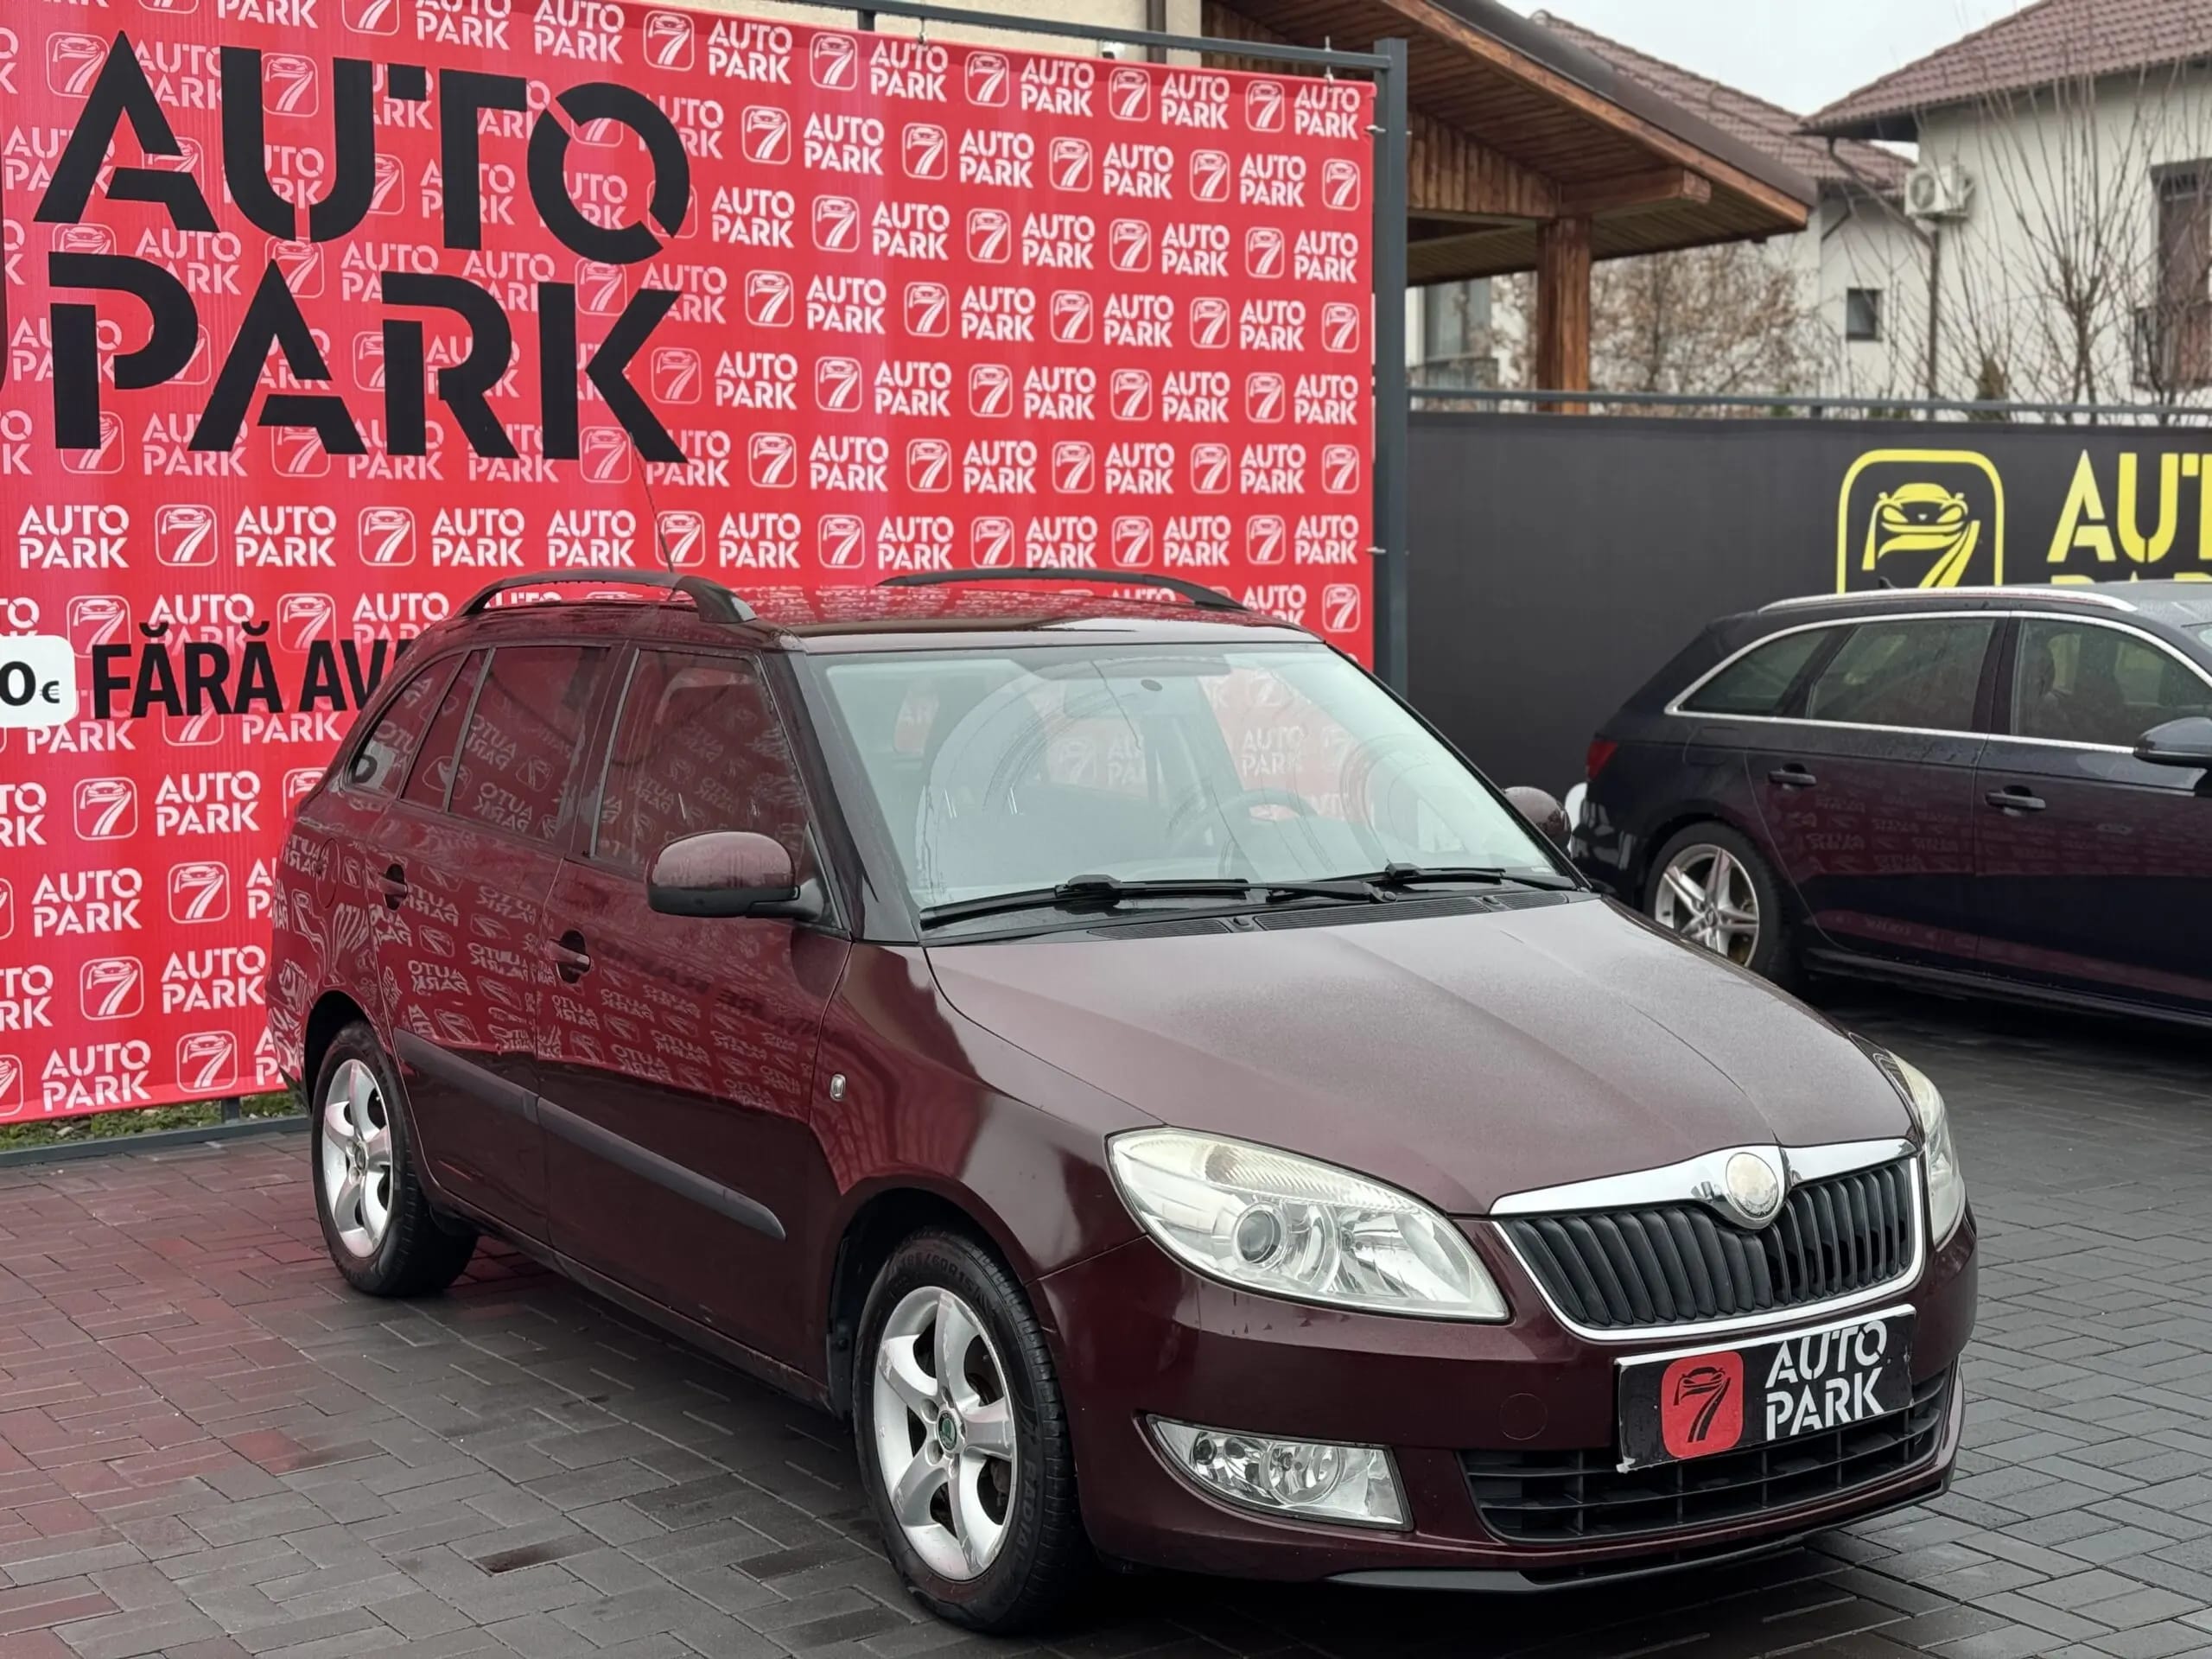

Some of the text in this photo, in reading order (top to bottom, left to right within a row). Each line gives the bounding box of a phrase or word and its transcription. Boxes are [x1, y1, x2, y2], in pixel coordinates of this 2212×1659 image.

[416, 11, 510, 50] PARK
[533, 0, 624, 33] AUTO
[535, 25, 622, 63] PARK
[708, 20, 792, 54] AUTO
[709, 47, 791, 84] PARK
[869, 40, 948, 73] AUTO
[871, 67, 946, 102] PARK
[1020, 59, 1094, 89] AUTO
[1161, 74, 1229, 103] AUTO
[1021, 83, 1092, 117] PARK
[1161, 98, 1229, 129] PARK
[1294, 86, 1360, 115] AUTO
[804, 112, 884, 146] AUTO
[1294, 110, 1360, 140] PARK
[33, 29, 690, 264] AUTO
[804, 141, 884, 175] PARK
[959, 130, 1034, 161] AUTO
[1103, 143, 1173, 172] AUTO
[960, 156, 1033, 188] PARK
[1240, 154, 1306, 181] AUTO
[1103, 168, 1173, 199] PARK
[1240, 179, 1306, 207] PARK
[712, 187, 795, 219] AUTO
[872, 201, 950, 232] AUTO
[713, 214, 793, 248] PARK
[1021, 213, 1095, 241] AUTO
[1161, 223, 1230, 251] AUTO
[136, 227, 241, 262] AUTO
[342, 240, 439, 273] AUTO
[872, 229, 950, 260] PARK
[1021, 239, 1095, 269] PARK
[1294, 231, 1358, 257] AUTO
[462, 250, 555, 281] AUTO
[1162, 248, 1228, 276] PARK
[1294, 256, 1358, 283] PARK
[640, 262, 728, 295] AUTO
[806, 276, 887, 307] AUTO
[961, 286, 1035, 315] AUTO
[1103, 294, 1173, 321] AUTO
[1240, 300, 1306, 326] AUTO
[807, 302, 885, 334] PARK
[962, 312, 1034, 341] PARK
[1103, 320, 1173, 347] PARK
[1240, 325, 1306, 351] PARK
[48, 251, 689, 463] PARK
[715, 352, 798, 381] AUTO
[874, 360, 951, 389] AUTO
[1023, 366, 1096, 393] AUTO
[1162, 372, 1230, 397] AUTO
[1294, 375, 1358, 400] AUTO
[716, 379, 797, 410] PARK
[875, 387, 950, 416] PARK
[1023, 392, 1096, 420] PARK
[1162, 397, 1230, 422] PARK
[1294, 399, 1358, 424] PARK
[143, 444, 248, 476] PARK
[347, 449, 444, 480] PARK
[810, 435, 888, 464] AUTO
[963, 441, 1037, 467] AUTO
[1105, 442, 1174, 467] AUTO
[1240, 444, 1306, 468] AUTO
[468, 454, 560, 484] PARK
[646, 461, 732, 489] PARK
[810, 462, 887, 492] PARK
[964, 467, 1035, 493] PARK
[1105, 468, 1174, 493] PARK
[1240, 468, 1306, 493] PARK
[18, 505, 129, 536] AUTO
[234, 506, 336, 536] AUTO
[431, 508, 524, 537] AUTO
[547, 510, 636, 537] AUTO
[719, 513, 801, 540] AUTO
[877, 517, 954, 543] AUTO
[1026, 516, 1097, 542] AUTO
[1163, 516, 1230, 541] AUTO
[1294, 515, 1358, 539] AUTO
[20, 537, 129, 569] PARK
[236, 537, 335, 567] PARK
[433, 537, 524, 567] PARK
[549, 538, 635, 568] PARK
[719, 540, 800, 568] PARK
[878, 543, 952, 570] PARK
[1026, 543, 1097, 569] PARK
[1163, 541, 1230, 567] PARK
[1294, 539, 1358, 564] PARK
[149, 593, 255, 625] AUTO
[352, 592, 450, 622] AUTO
[1242, 584, 1306, 610] AUTO
[92, 620, 283, 719] FĂRĂ
[299, 637, 416, 712] AV
[27, 720, 137, 755] PARK
[242, 711, 344, 745] PARK
[156, 771, 260, 804] AUTO
[157, 802, 259, 836] PARK
[32, 868, 142, 904] AUTO
[34, 899, 141, 937] PARK
[162, 945, 265, 982] AUTO
[163, 976, 264, 1013] PARK
[41, 1040, 150, 1079] AUTO
[43, 1071, 151, 1111] PARK
[1765, 1319, 1888, 1389] AUTO
[1765, 1367, 1885, 1440] PARK
